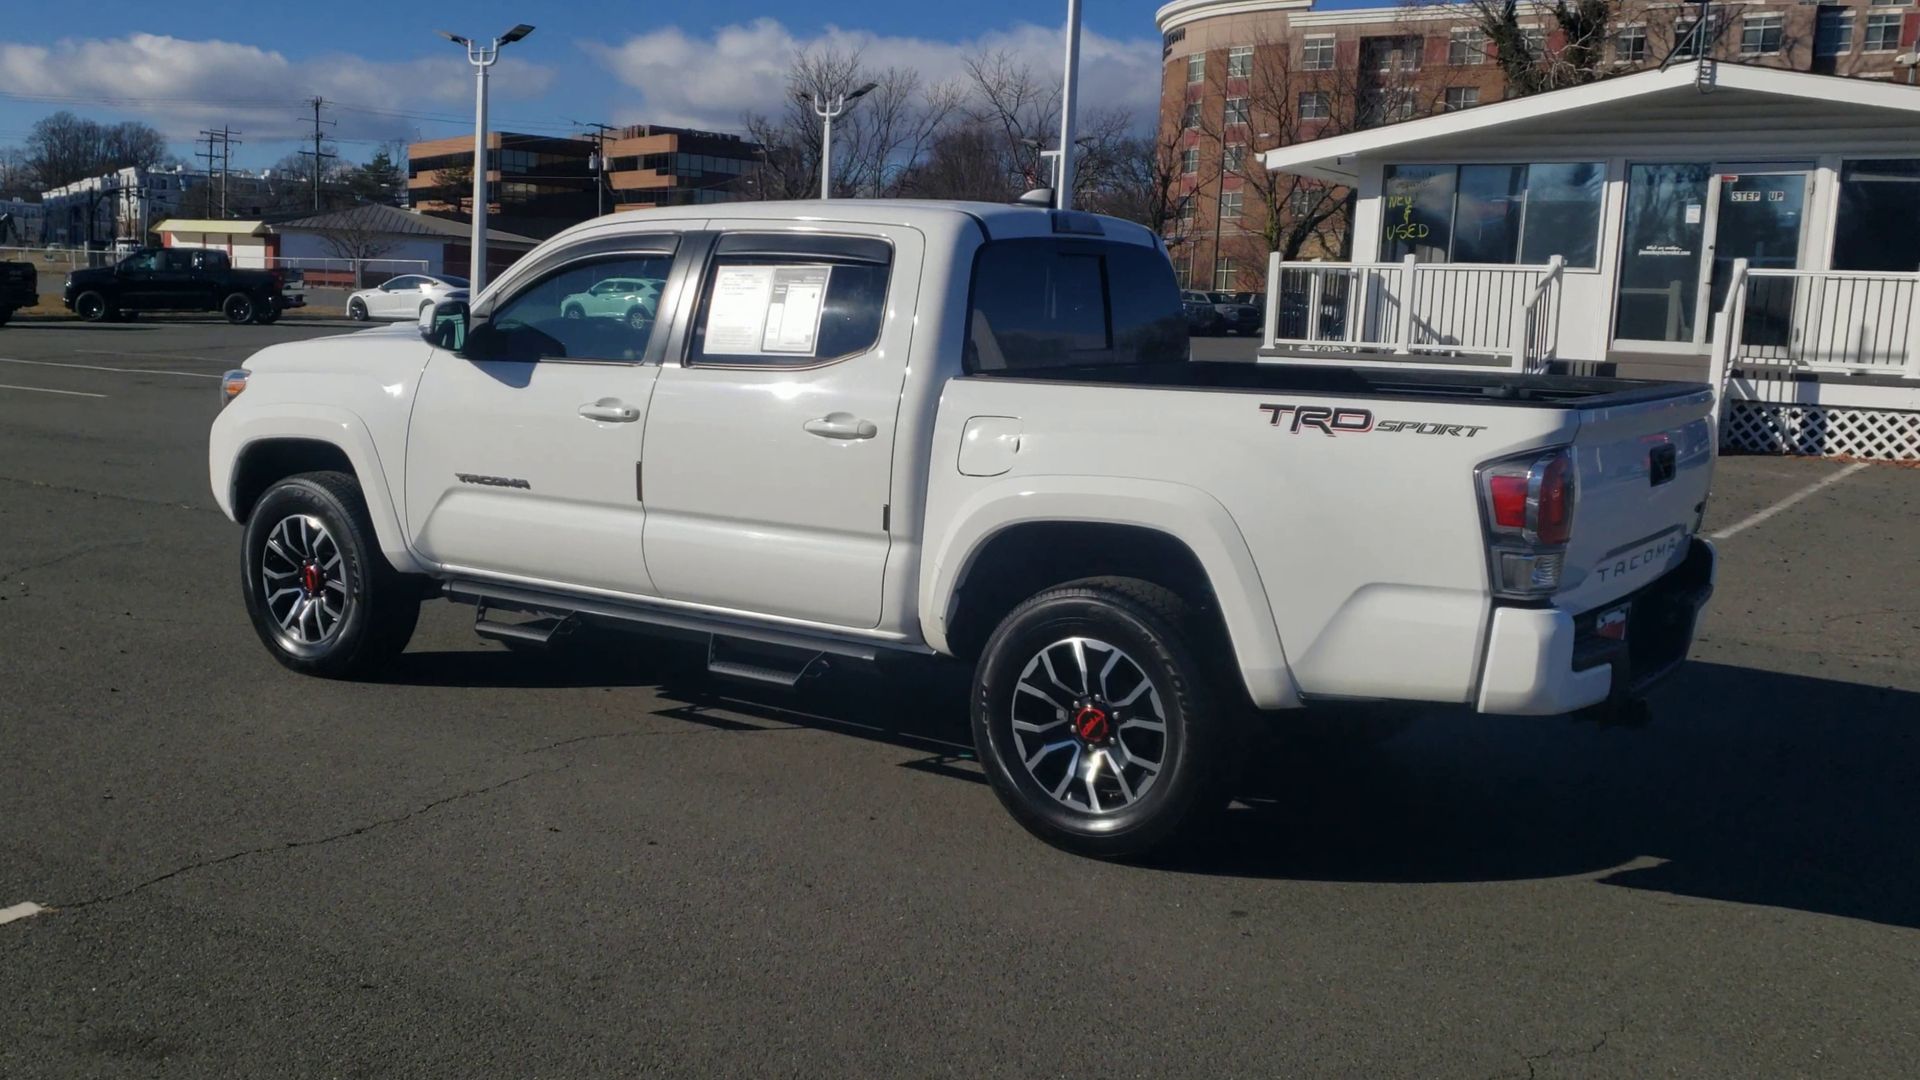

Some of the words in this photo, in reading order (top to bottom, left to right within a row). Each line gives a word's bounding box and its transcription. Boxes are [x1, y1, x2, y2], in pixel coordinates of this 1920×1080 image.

[1733, 192, 1759, 201] STEP
[1770, 192, 1783, 201] UP
[1387, 223, 1429, 240] USED
[1259, 403, 1374, 437] TRD
[1375, 420, 1488, 438] SPORT
[455, 473, 531, 490] TACOMA
[1597, 538, 1677, 582] TACOMA
